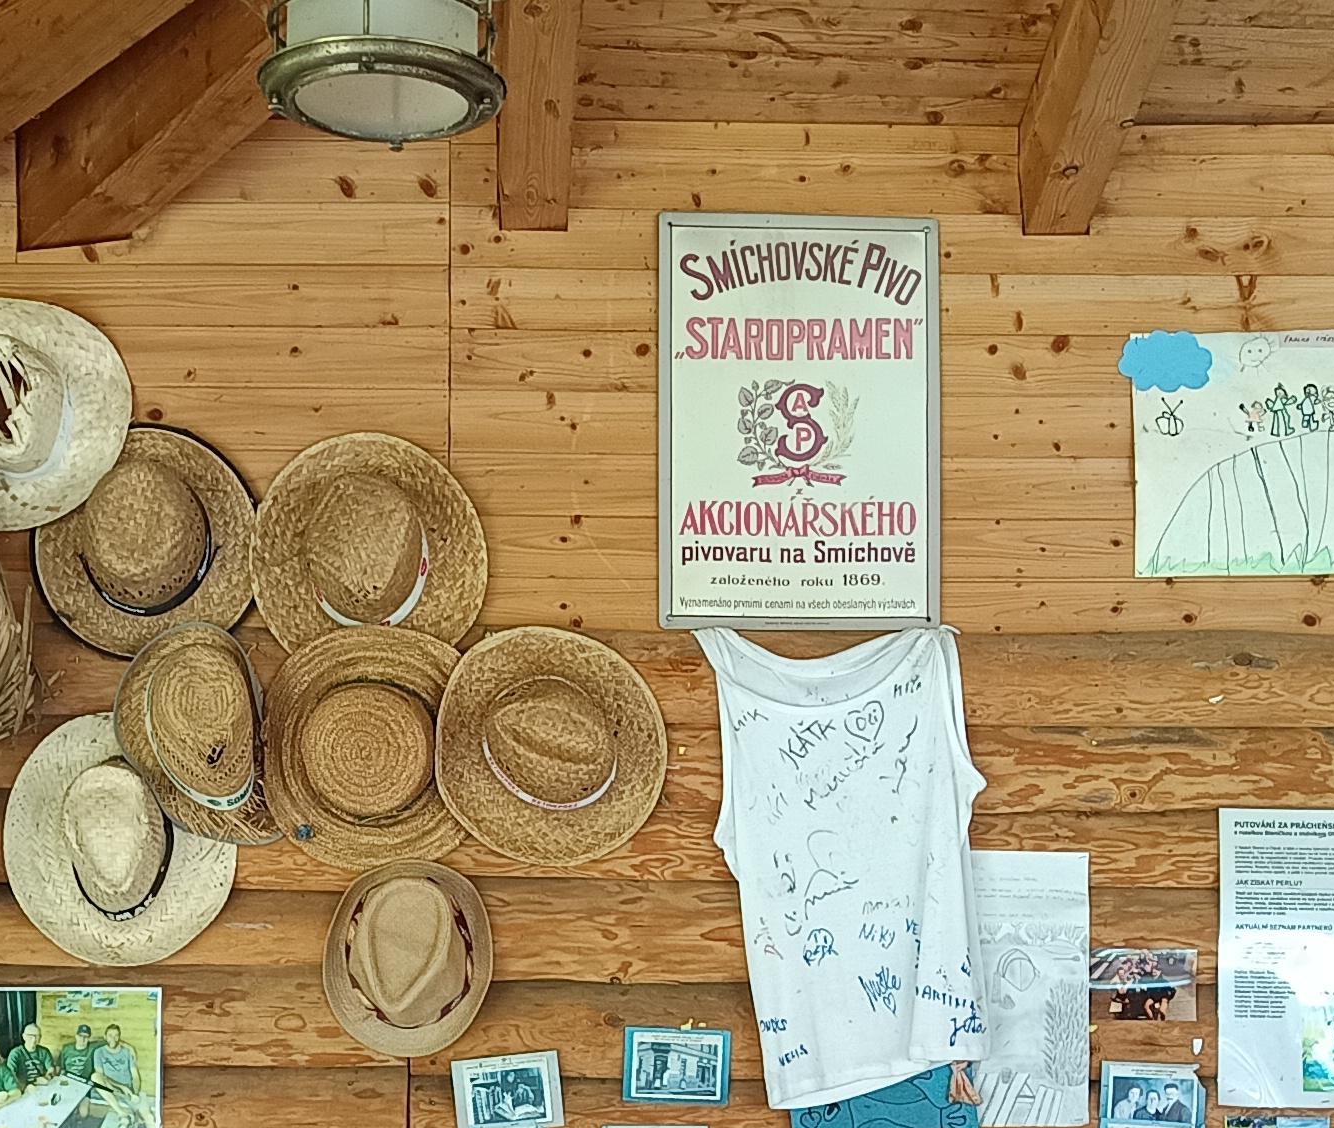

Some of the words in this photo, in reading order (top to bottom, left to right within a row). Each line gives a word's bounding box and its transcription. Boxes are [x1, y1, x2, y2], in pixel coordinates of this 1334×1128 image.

[679, 239, 859, 300] SMÍCHOVSKÉ
[856, 242, 922, 306] PIVO
[679, 496, 916, 538] AKCIONÁŘSKÉHO
[682, 540, 771, 565] pivovaru
[780, 547, 806, 564] na
[814, 540, 915, 564] Smíchově
[710, 573, 790, 588] založeného
[800, 577, 833, 587] roku
[680, 596, 732, 609] Vyznamenáno
[765, 599, 793, 609] cenami
[796, 600, 805, 609] na
[808, 598, 830, 609] všech
[833, 597, 876, 610] obeslaných
[1235, 820, 1276, 829] PUTOVÁNÍ
